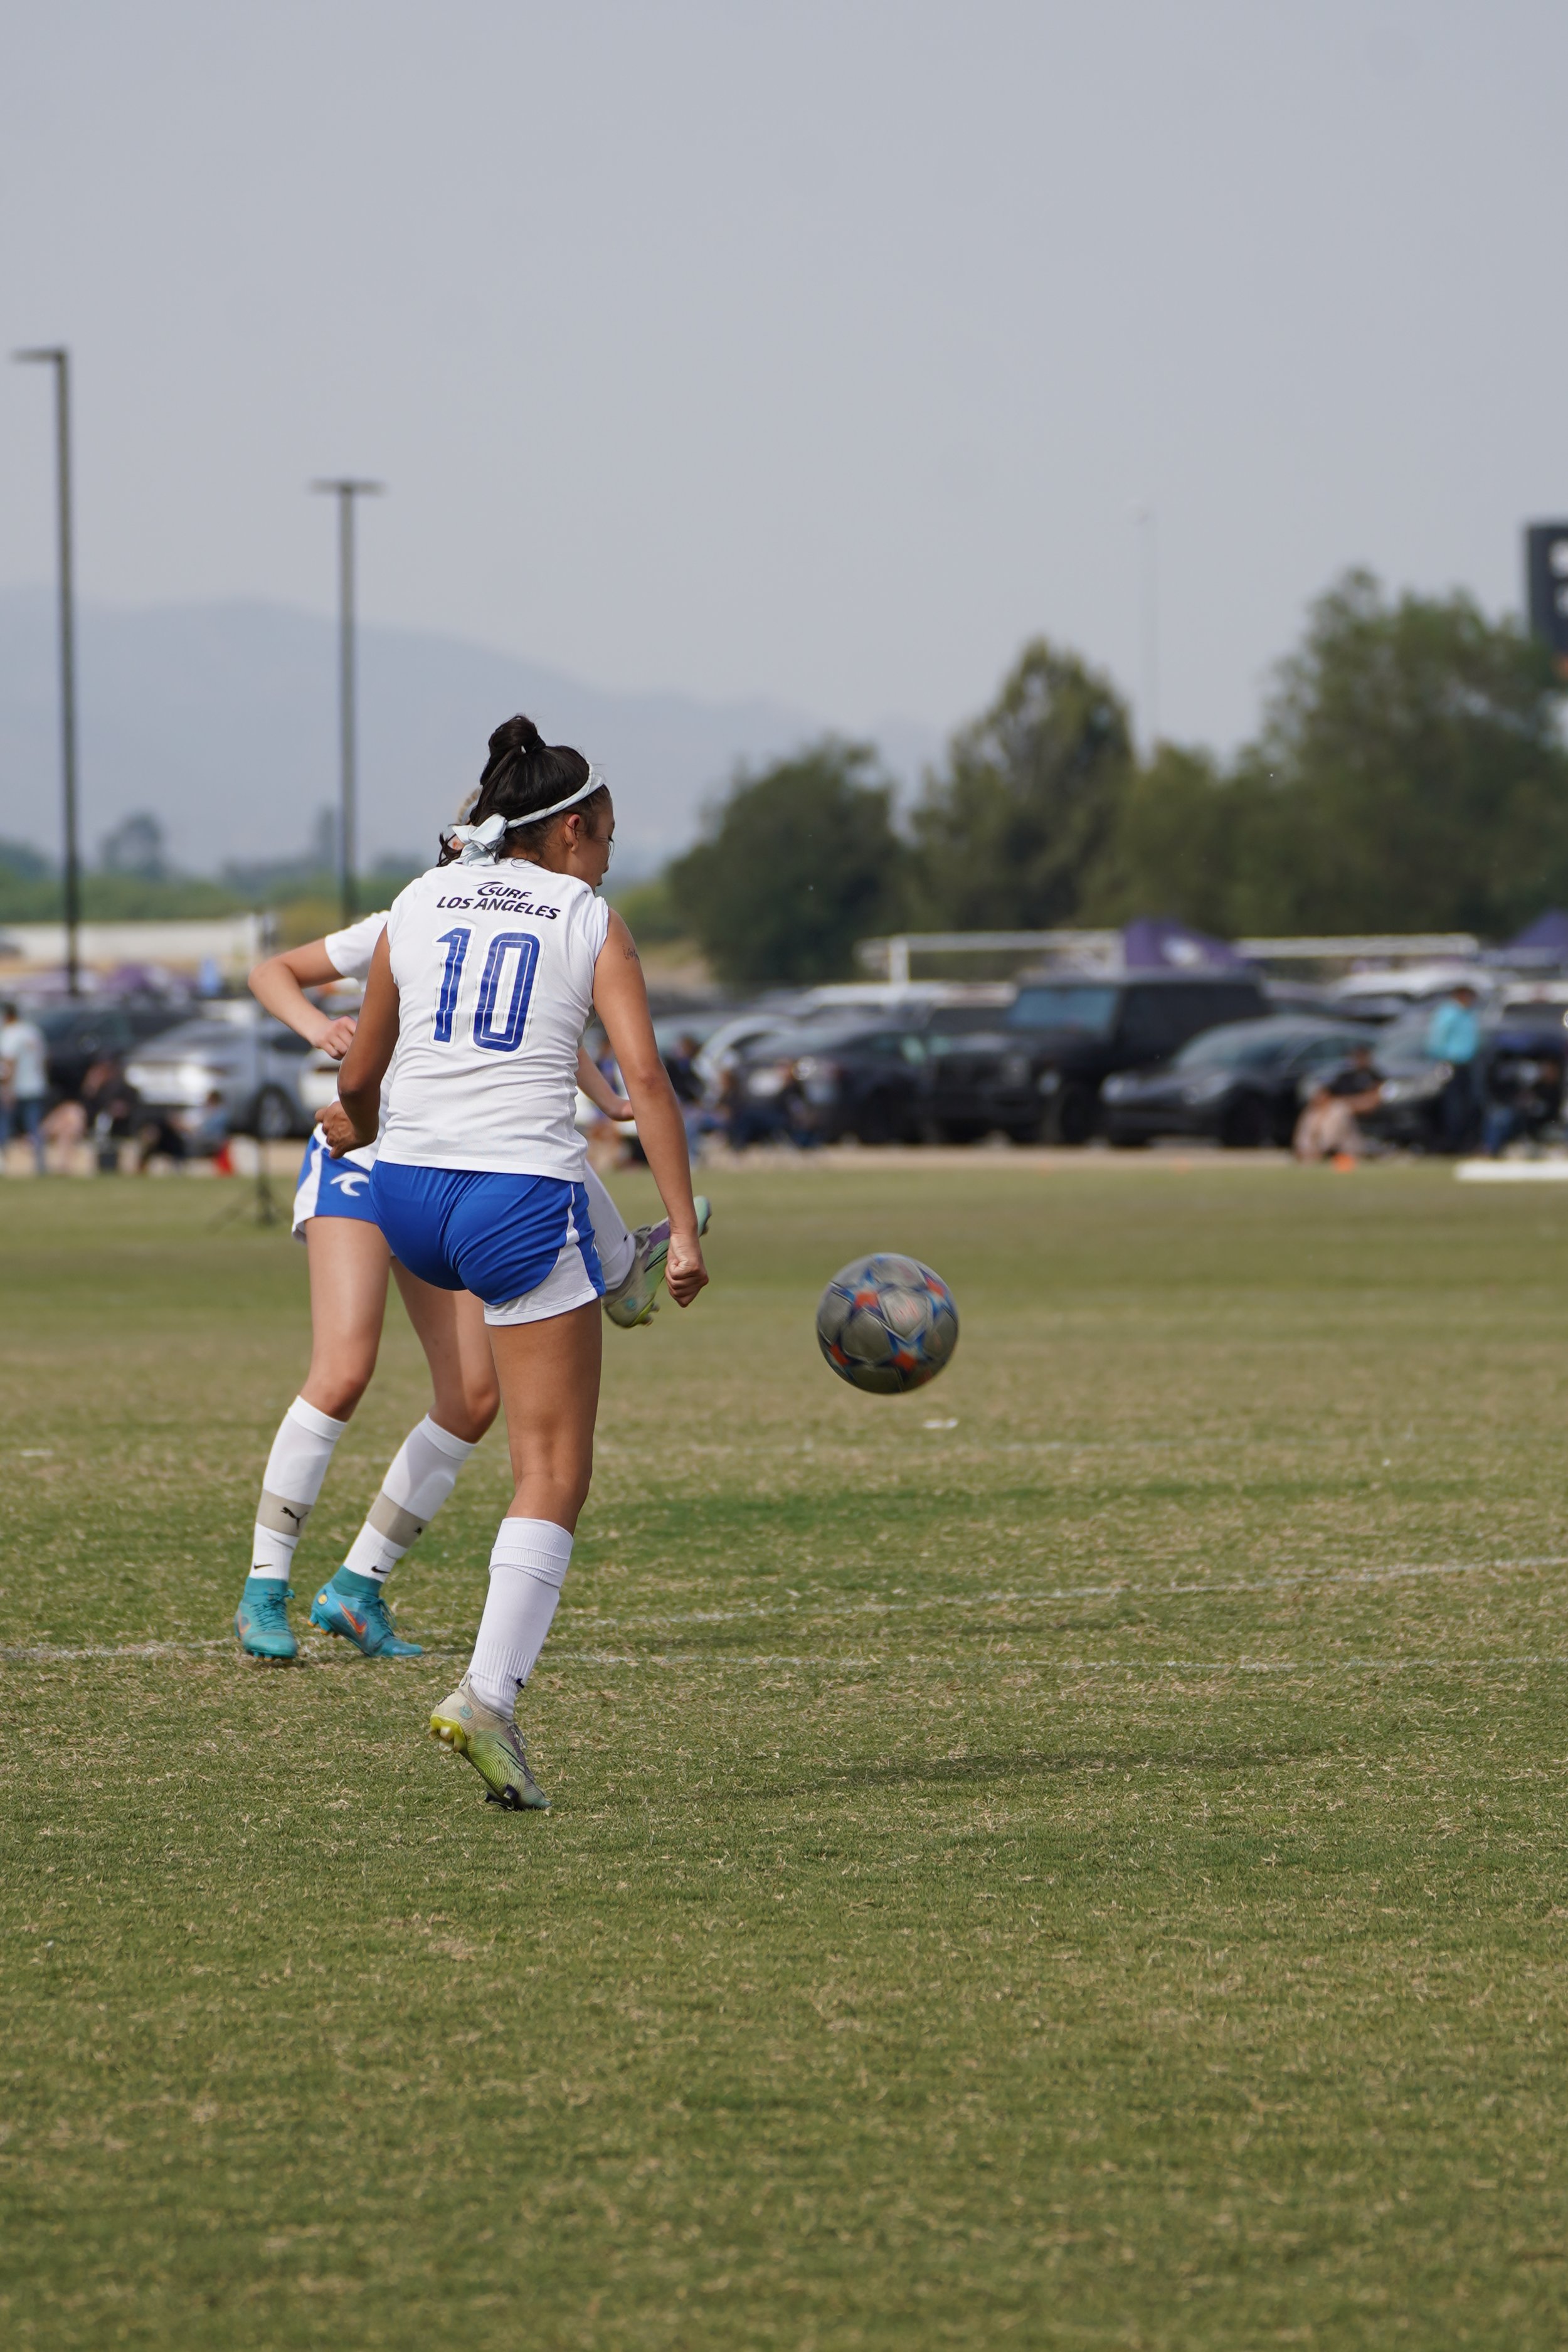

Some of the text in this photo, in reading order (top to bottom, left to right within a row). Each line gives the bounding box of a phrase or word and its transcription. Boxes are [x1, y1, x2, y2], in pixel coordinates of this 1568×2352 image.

[437, 896, 561, 920] LOS ANGELES
[433, 927, 541, 1052] 10
